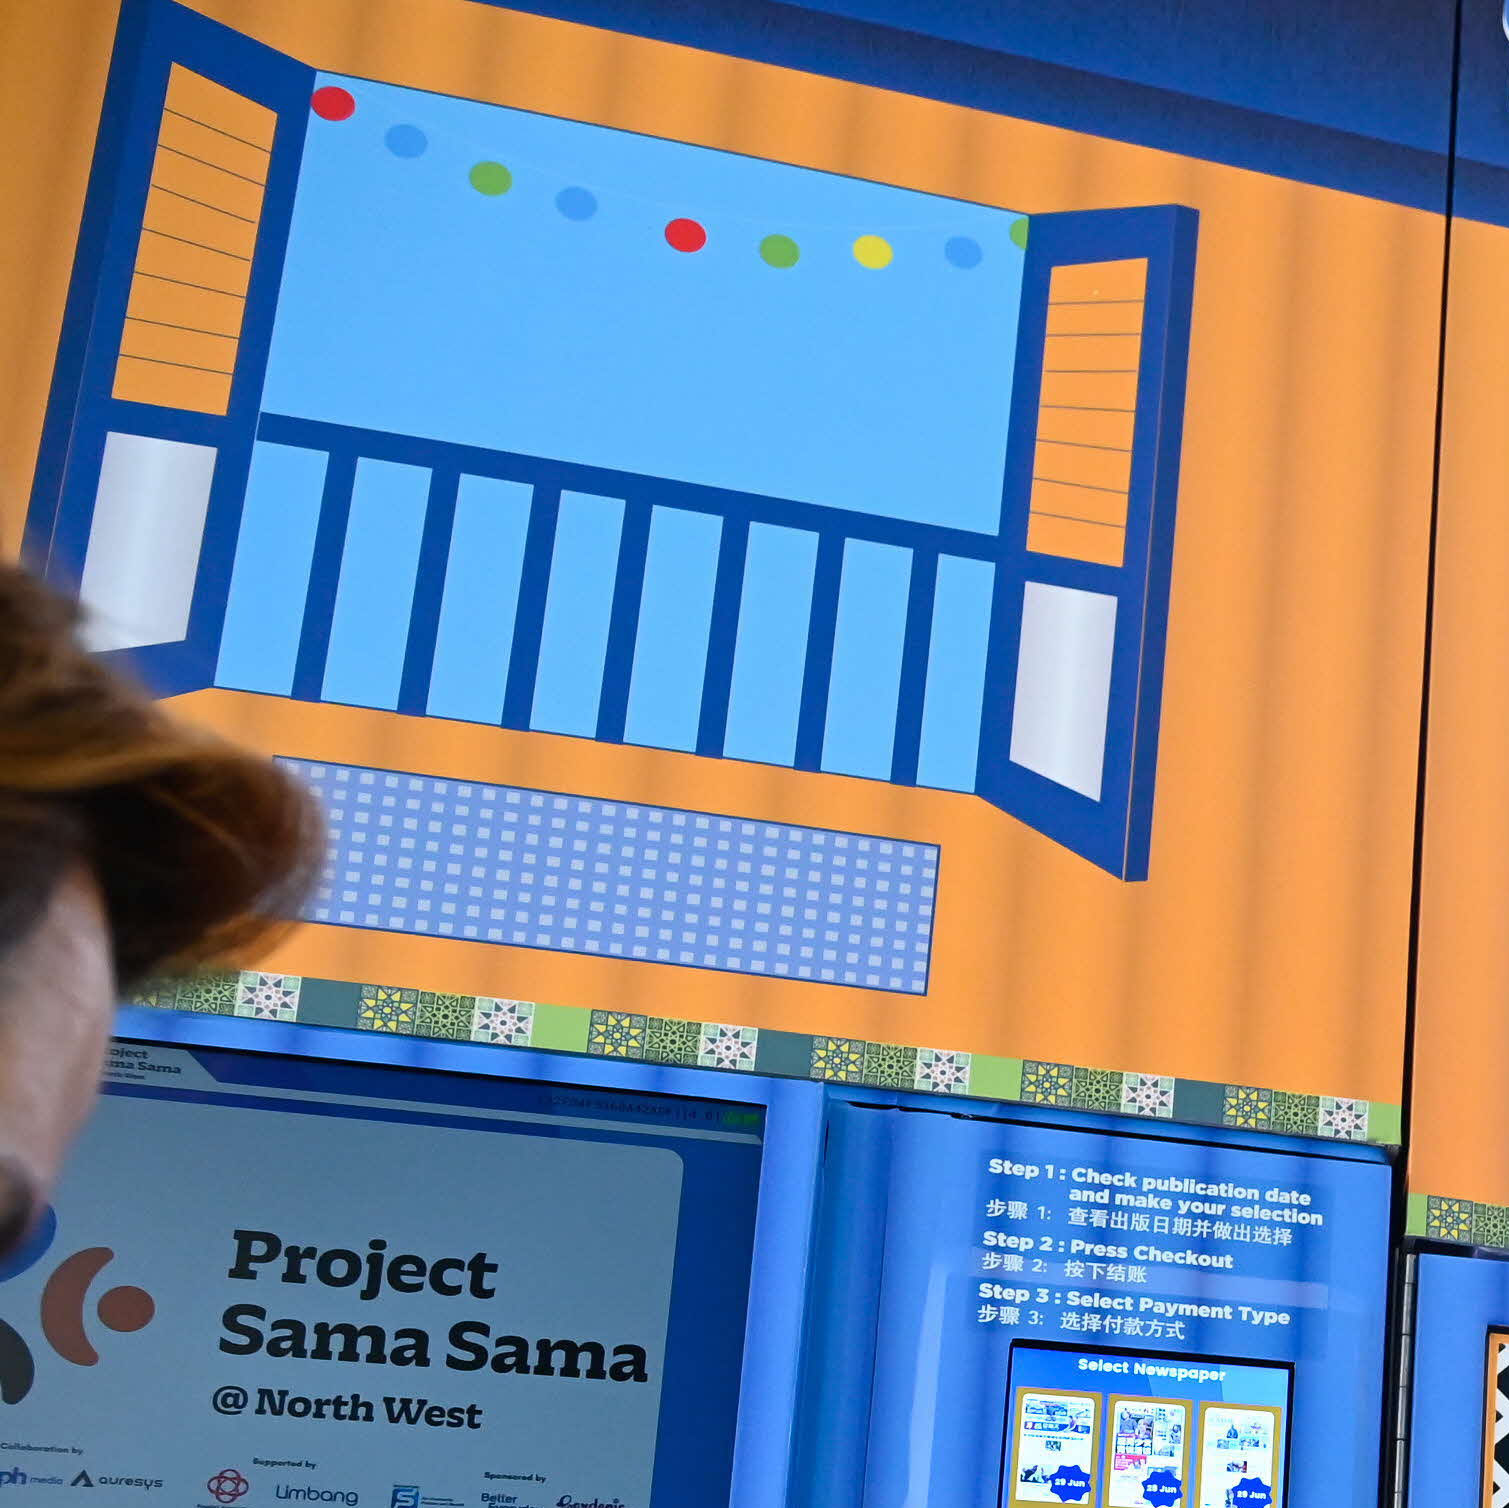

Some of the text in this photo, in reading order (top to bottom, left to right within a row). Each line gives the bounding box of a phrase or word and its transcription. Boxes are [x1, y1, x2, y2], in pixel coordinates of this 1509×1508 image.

[988, 1157, 1312, 1207] Step Check publication date
[985, 1198, 1294, 1247] 步骤 查看出版日期并做出选择
[1068, 1186, 1324, 1227] and make your selection
[227, 1228, 499, 1301] Project
[981, 1251, 1148, 1285] 步骤 按下结账
[982, 1230, 1234, 1270] Step Press Checkout
[976, 1303, 1186, 1341] 步骤 选择付款方式
[978, 1281, 1291, 1326] Step Select Payment Type
[218, 1303, 649, 1384] Sama Sama
[1077, 1357, 1227, 1384] Select Newspaper
[211, 1385, 484, 1430] @ North West
[98, 1475, 164, 1490] auresys
[275, 1484, 360, 1507] Limbang
[484, 1472, 534, 1483] Sponsored
[481, 1492, 518, 1505] Better
